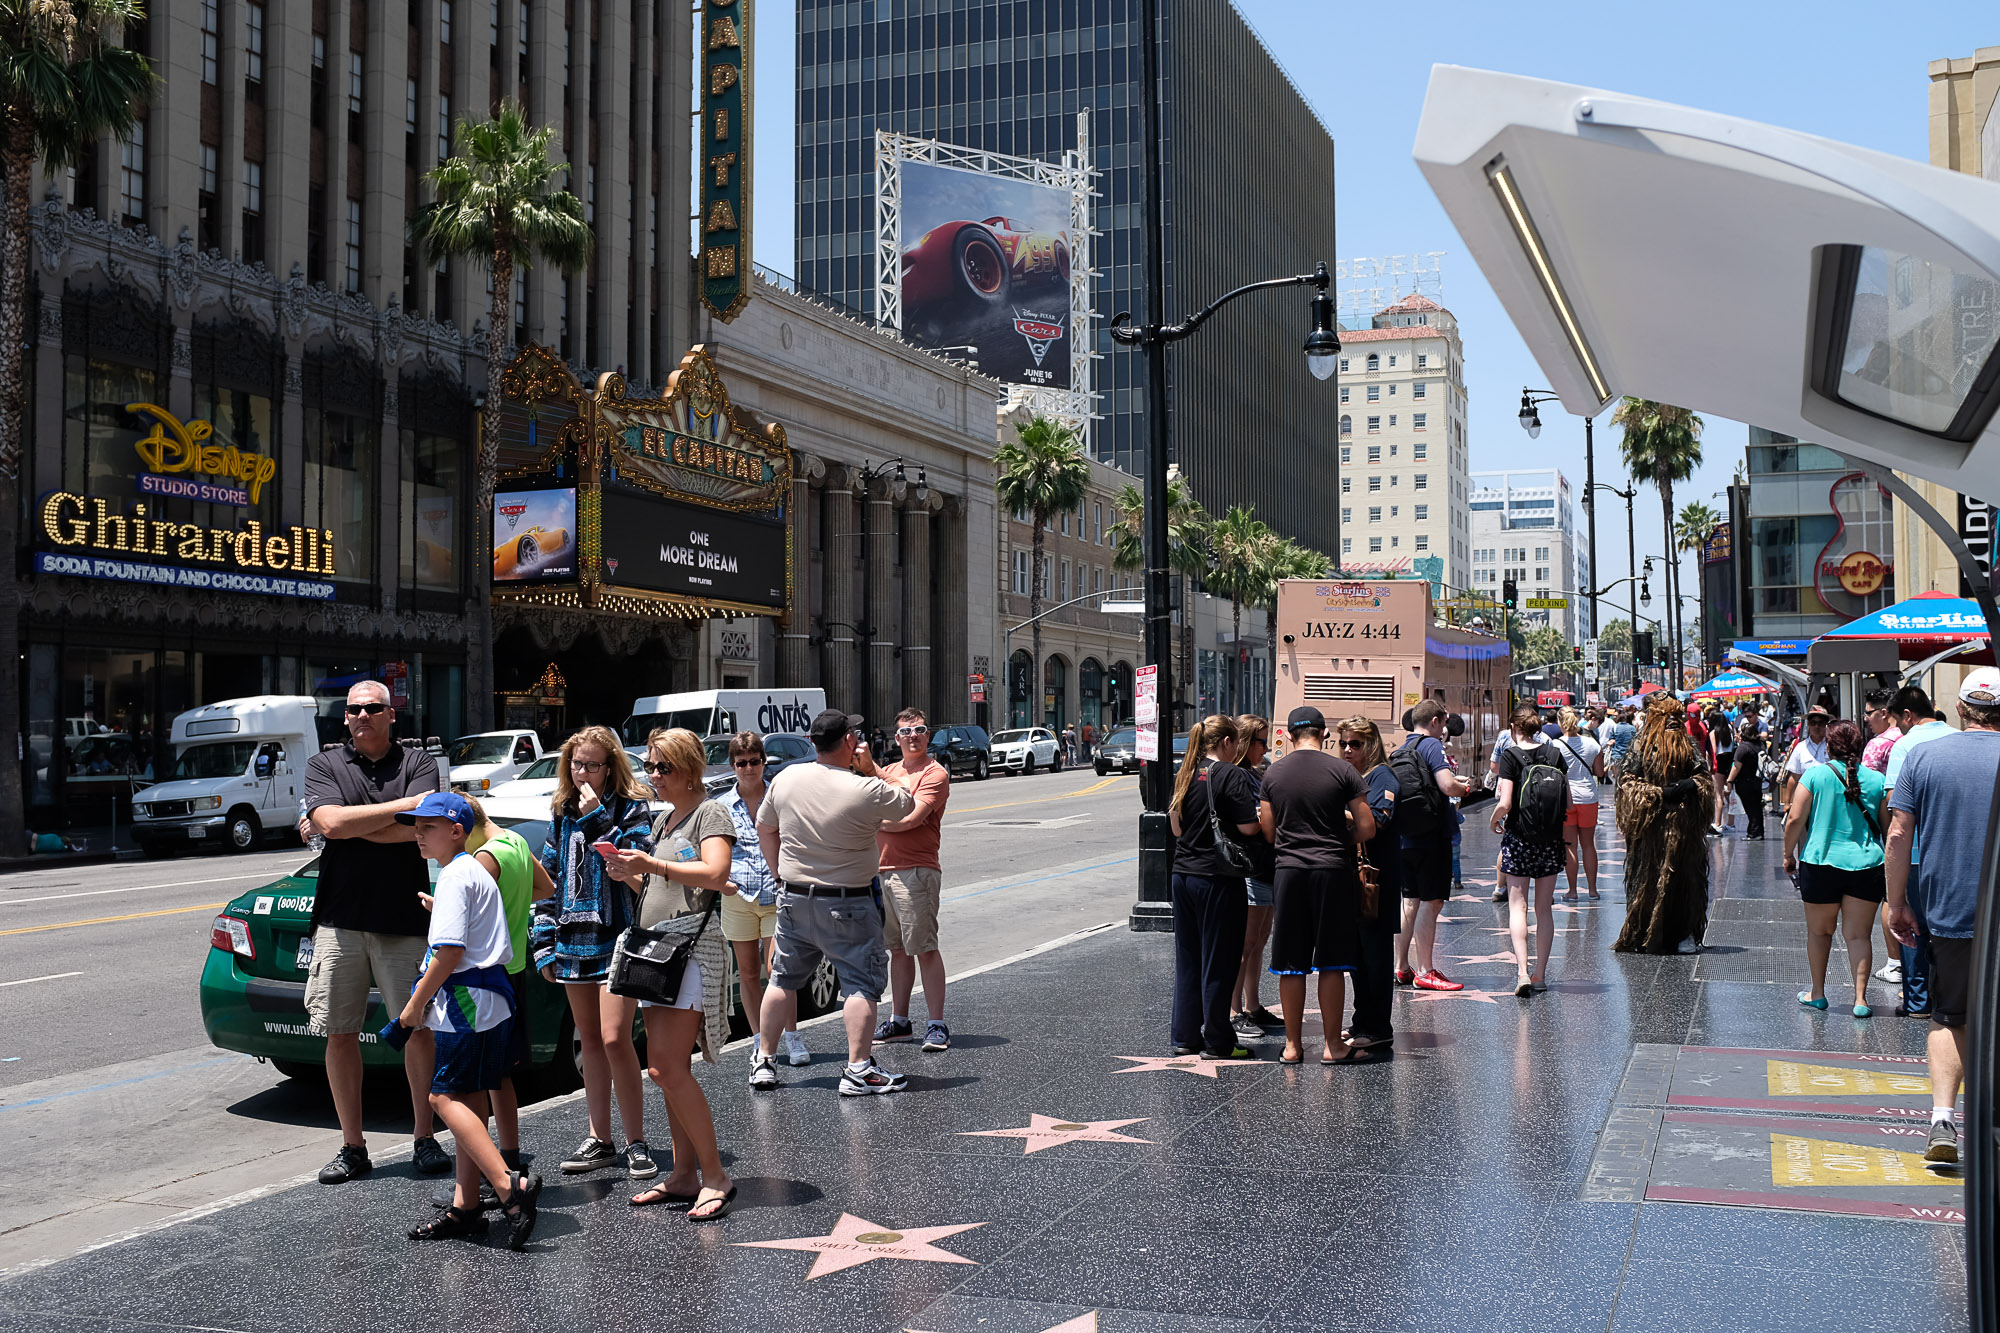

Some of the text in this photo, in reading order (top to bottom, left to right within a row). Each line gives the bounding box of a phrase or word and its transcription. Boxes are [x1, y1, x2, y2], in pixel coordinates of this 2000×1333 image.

[705, 0, 740, 280] APITAN
[1019, 322, 1057, 337] Cars
[1033, 343, 1046, 357] 3
[1023, 368, 1053, 379] JUNE 16
[672, 435, 763, 481] CAPITAN
[142, 475, 248, 505] STUDIO STORE
[42, 491, 337, 576] Ghirardelli
[689, 530, 710, 547] ONE
[660, 543, 738, 574] MORE DREAM
[43, 554, 334, 599] SODA FOUNTAIN AND CHOCOLATE SHOP
[1821, 560, 1861, 577] Hard
[1302, 622, 1401, 640] JAY:Z 4:44
[757, 694, 811, 734] CINTAS
[1325, 740, 1336, 749] 17
[1886, 1077, 1929, 1091] NO
[993, 1130, 1070, 1138] FRAMPTON
[1786, 1139, 1814, 1183] PEDESTRIANS
[1821, 1153, 1870, 1172] NO
[810, 1242, 916, 1255] JERRY LEWIS
